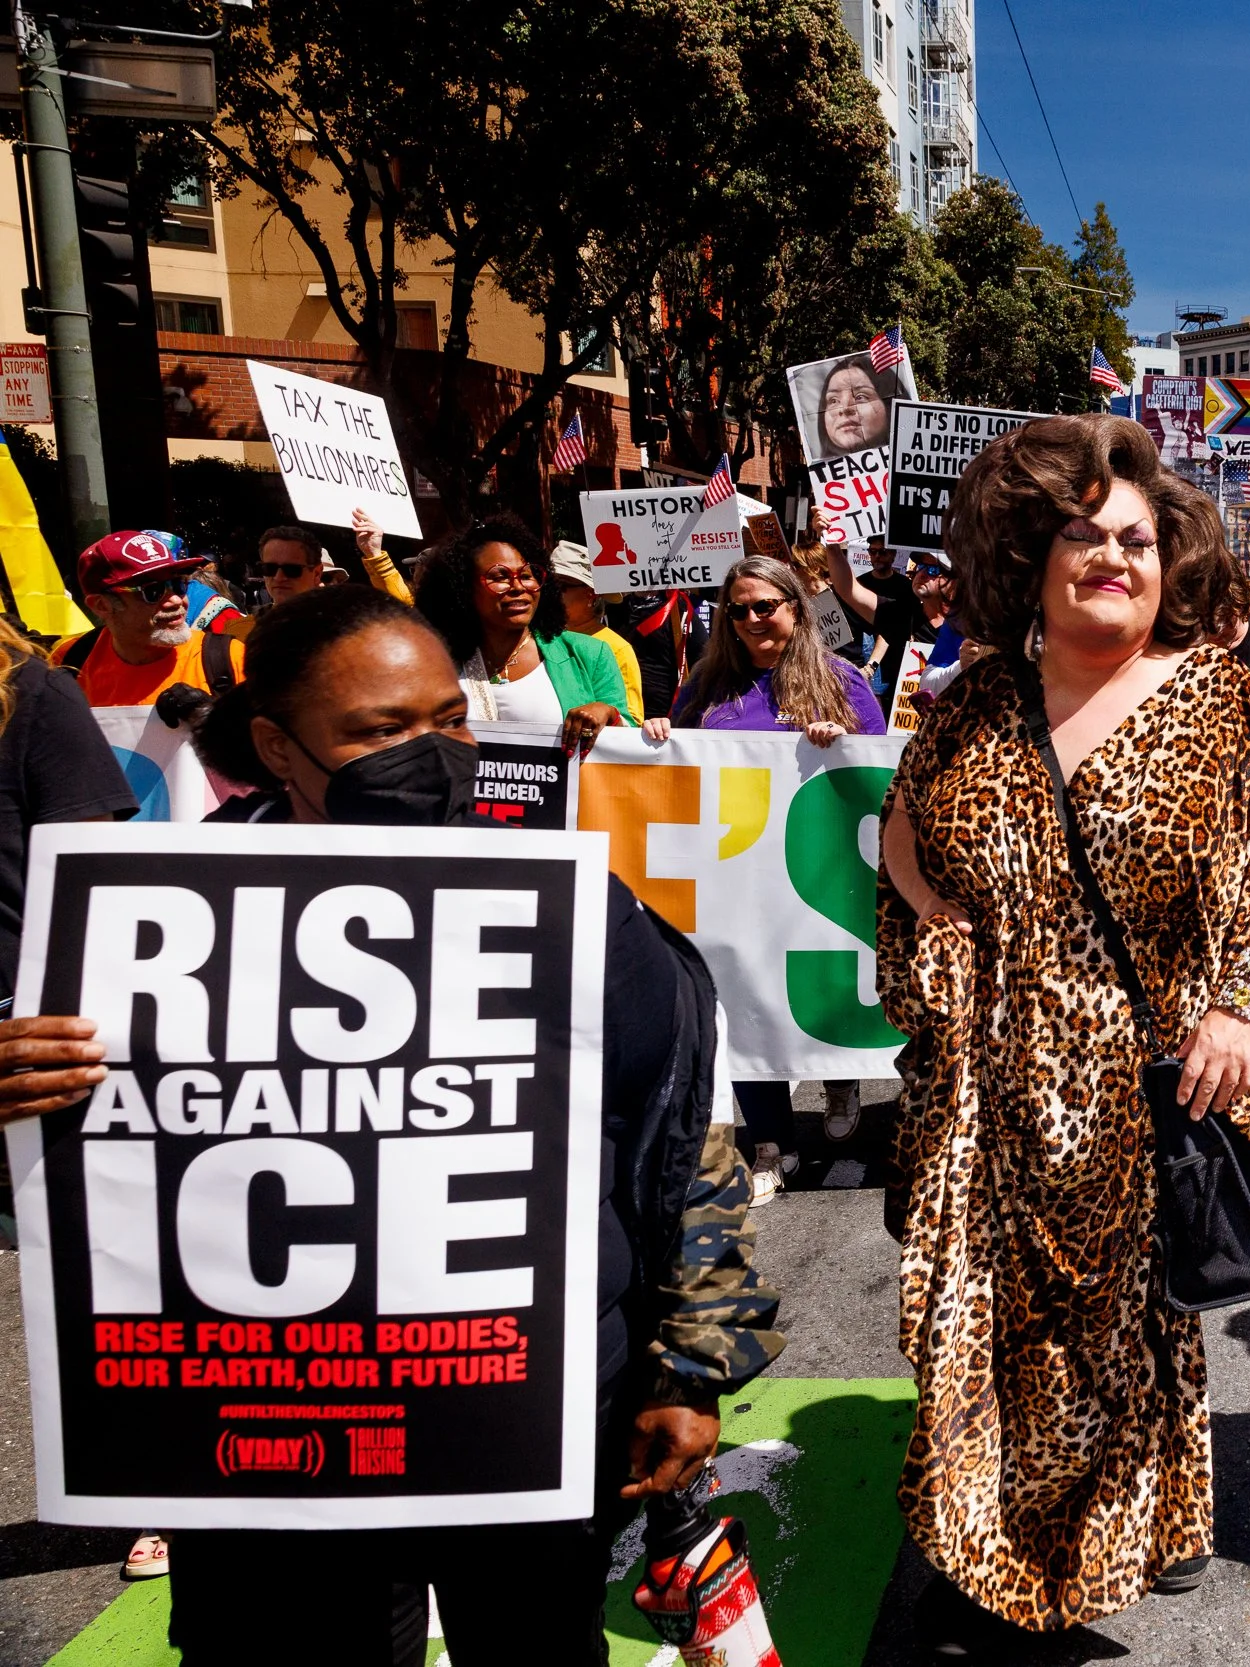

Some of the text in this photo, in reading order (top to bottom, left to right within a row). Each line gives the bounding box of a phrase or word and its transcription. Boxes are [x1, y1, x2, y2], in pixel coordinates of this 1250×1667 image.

[4, 361, 45, 375] STOPPING
[6, 378, 29, 391] ANY
[1152, 380, 1197, 396] COMPTON'S
[5, 393, 33, 407] TIME
[1145, 393, 1203, 411] CAFETERIA RIOT
[274, 384, 381, 441] TAX THE
[916, 411, 981, 434] IT'S NO
[911, 433, 923, 450] A
[271, 433, 408, 497] BILLIONAIRES
[898, 486, 932, 506] IT'S
[612, 496, 705, 518] HISTORY
[651, 514, 675, 532] does
[656, 532, 675, 550] not
[691, 531, 738, 545] RESIST!
[647, 553, 688, 573] forgive
[628, 566, 712, 588] SILENCE
[902, 681, 914, 693] NO
[894, 713, 912, 728] NO
[79, 885, 539, 1064] RISE
[82, 1063, 535, 1136] AGAINST
[82, 1131, 535, 1318] ICE
[94, 1316, 529, 1353] RISE FOR OUR BODIES,
[94, 1352, 527, 1393] OUR EARTH, OUR FUTURE
[218, 1404, 406, 1419] #UNTILTHEVIOLENCESTOPS
[358, 1427, 406, 1449] BILLION
[358, 1448, 406, 1475] RISING
